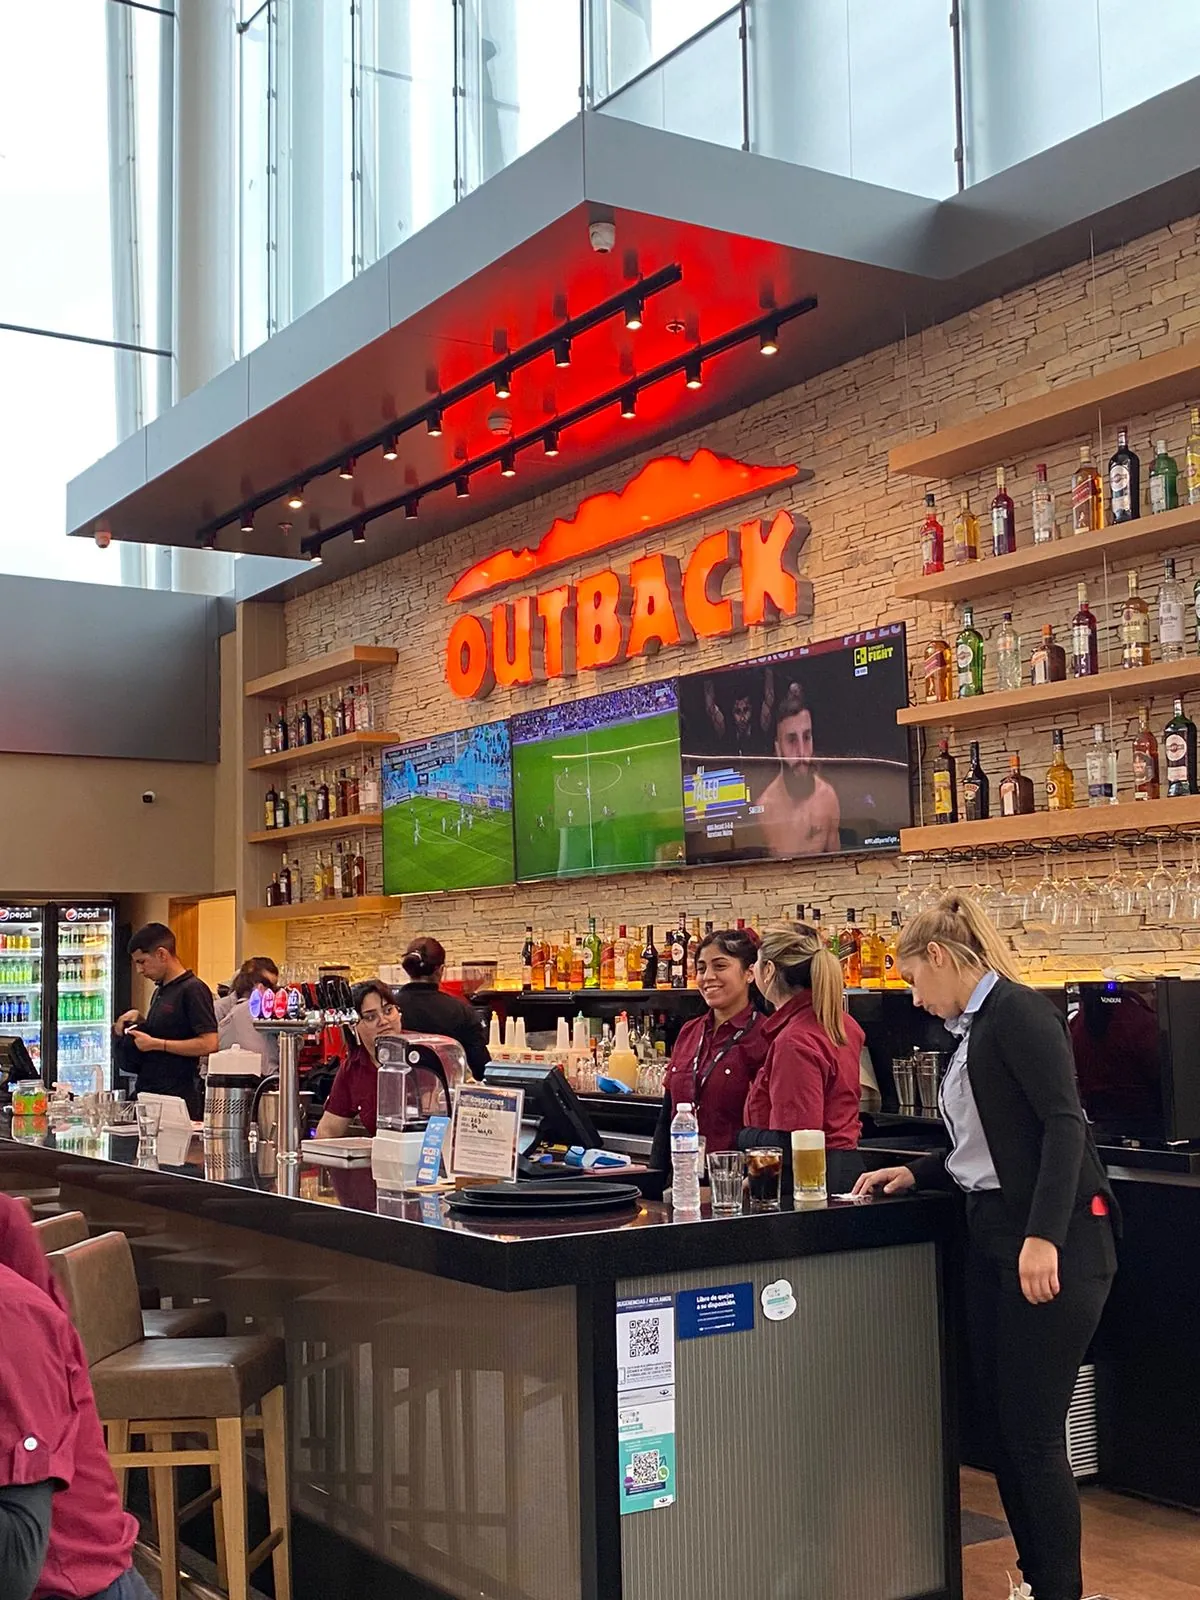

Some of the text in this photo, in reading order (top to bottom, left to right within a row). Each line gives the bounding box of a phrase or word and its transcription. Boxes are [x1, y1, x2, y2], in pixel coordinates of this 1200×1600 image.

[446, 509, 800, 700] OUTBACK
[868, 647, 894, 662] FIGHT
[9, 909, 32, 919] pepsi
[77, 909, 100, 919] pepsi
[717, 1293, 735, 1301] quejas
[707, 1300, 736, 1309] disposición
